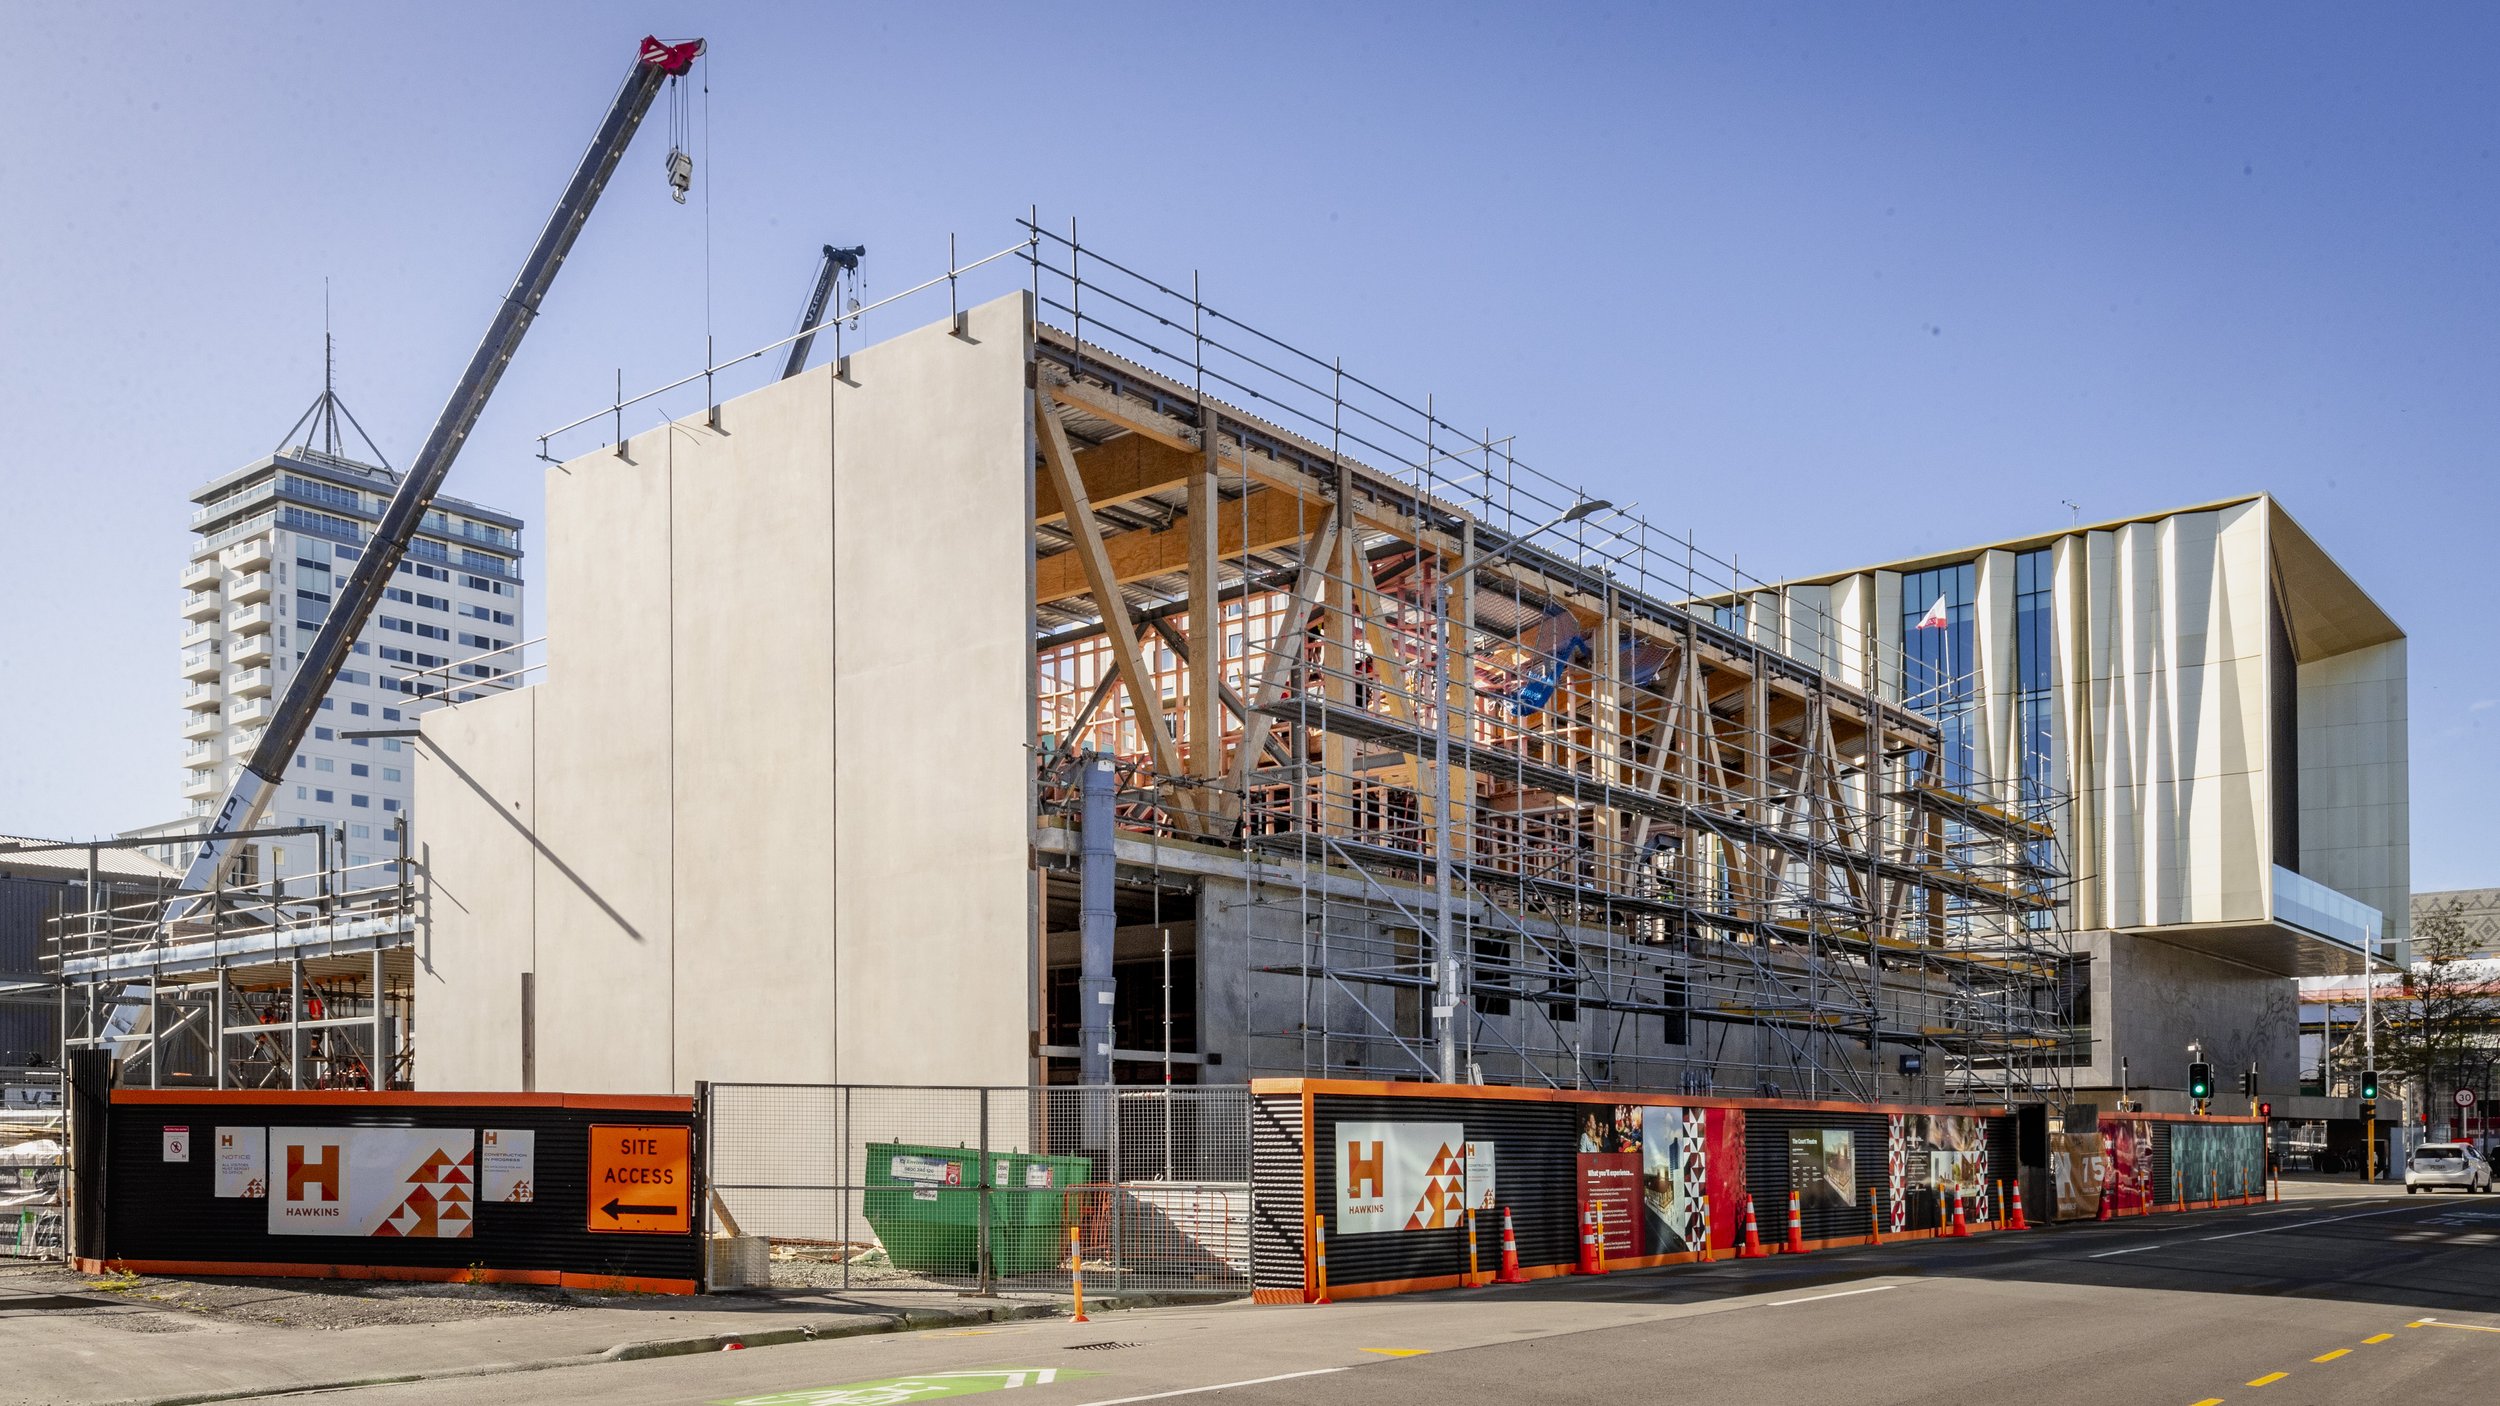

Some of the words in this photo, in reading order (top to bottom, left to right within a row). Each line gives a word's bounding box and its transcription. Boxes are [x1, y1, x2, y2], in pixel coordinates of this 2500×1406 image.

[2459, 1094, 2472, 1102] 30
[222, 1135, 232, 1146] H
[485, 1131, 498, 1145] H
[621, 1139, 658, 1155] SITE
[1467, 1144, 1475, 1156] H
[287, 1145, 339, 1201] H
[1348, 1141, 1383, 1198] H
[1587, 1169, 1598, 1177] What
[604, 1167, 674, 1185] ACCESS
[286, 1208, 339, 1217] HAWKINS
[1349, 1204, 1384, 1215] HAWKINS
